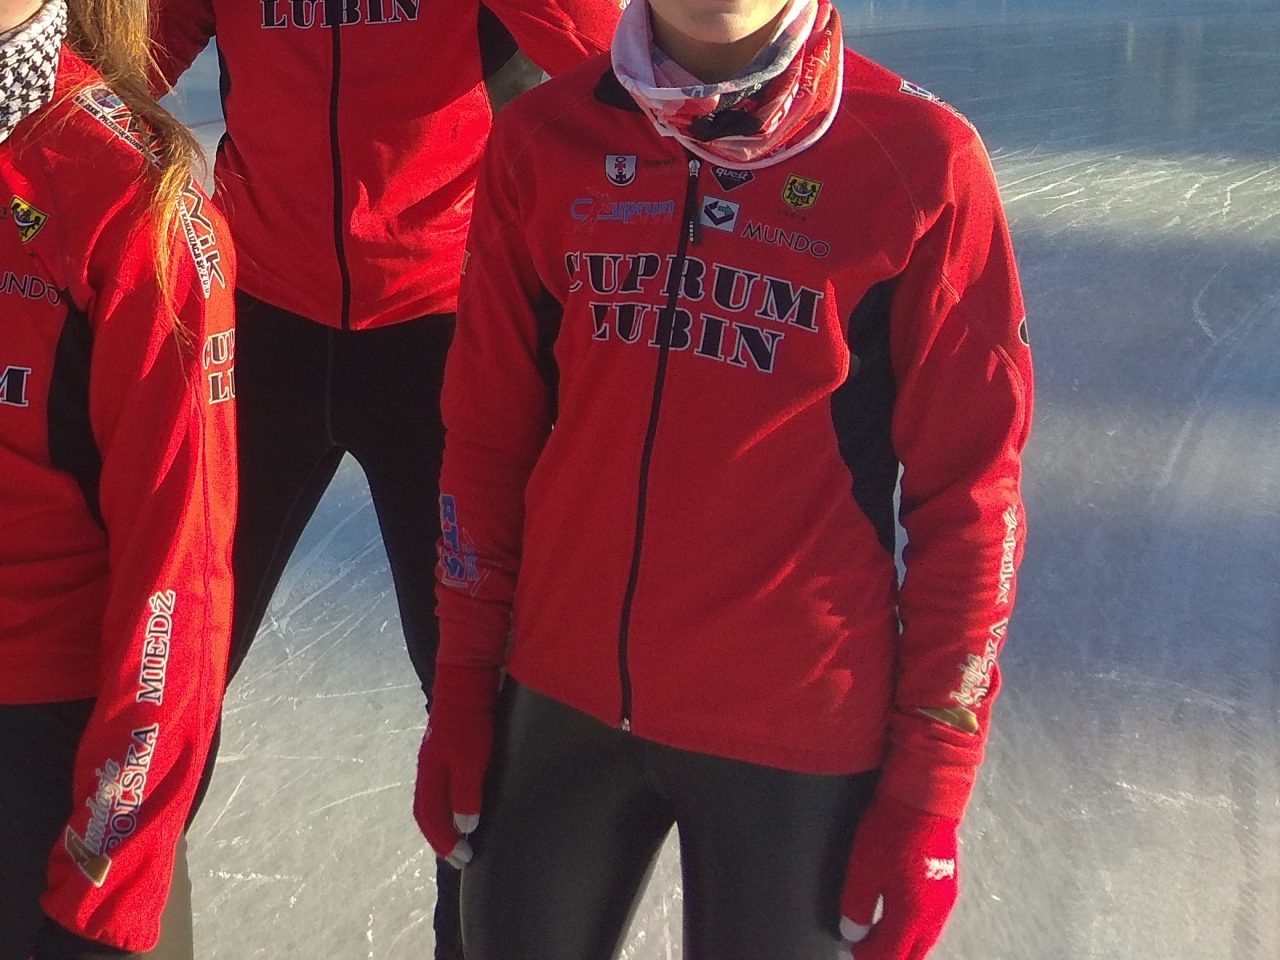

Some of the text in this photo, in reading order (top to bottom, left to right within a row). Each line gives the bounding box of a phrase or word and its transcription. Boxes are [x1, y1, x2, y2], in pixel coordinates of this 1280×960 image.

[741, 220, 830, 258] MUNDO
[565, 252, 825, 332] CUPRUM
[589, 301, 784, 373] LUBIN
[136, 589, 176, 706] MIEDŹ
